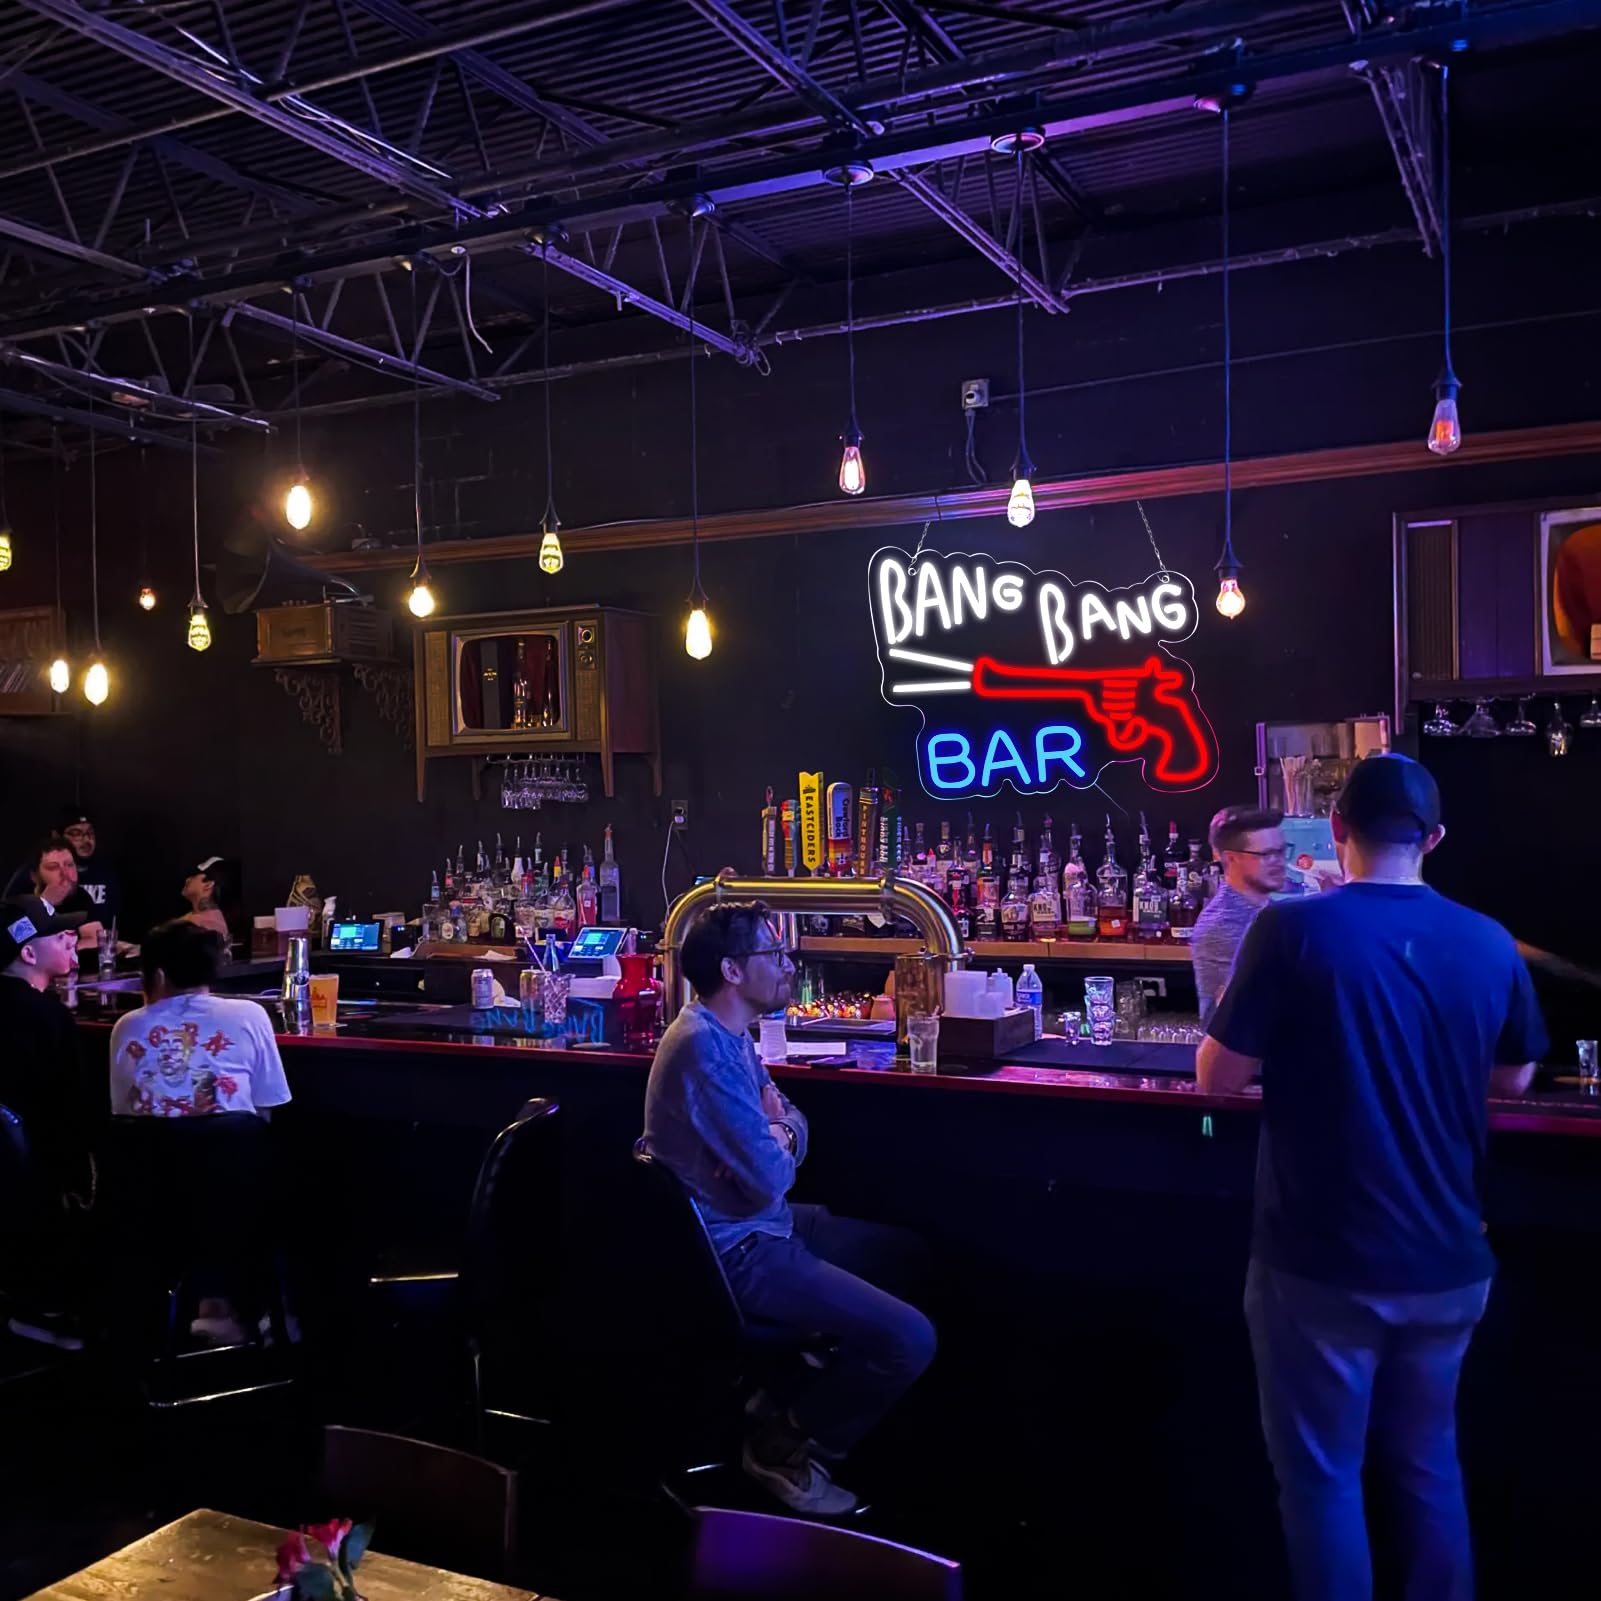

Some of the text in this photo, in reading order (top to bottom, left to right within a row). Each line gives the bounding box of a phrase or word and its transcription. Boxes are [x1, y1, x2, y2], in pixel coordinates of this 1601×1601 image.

[880, 559, 1187, 665] BANG BANG
[927, 725, 1086, 789] BAR
[805, 795, 816, 863] EASTCIDERS
